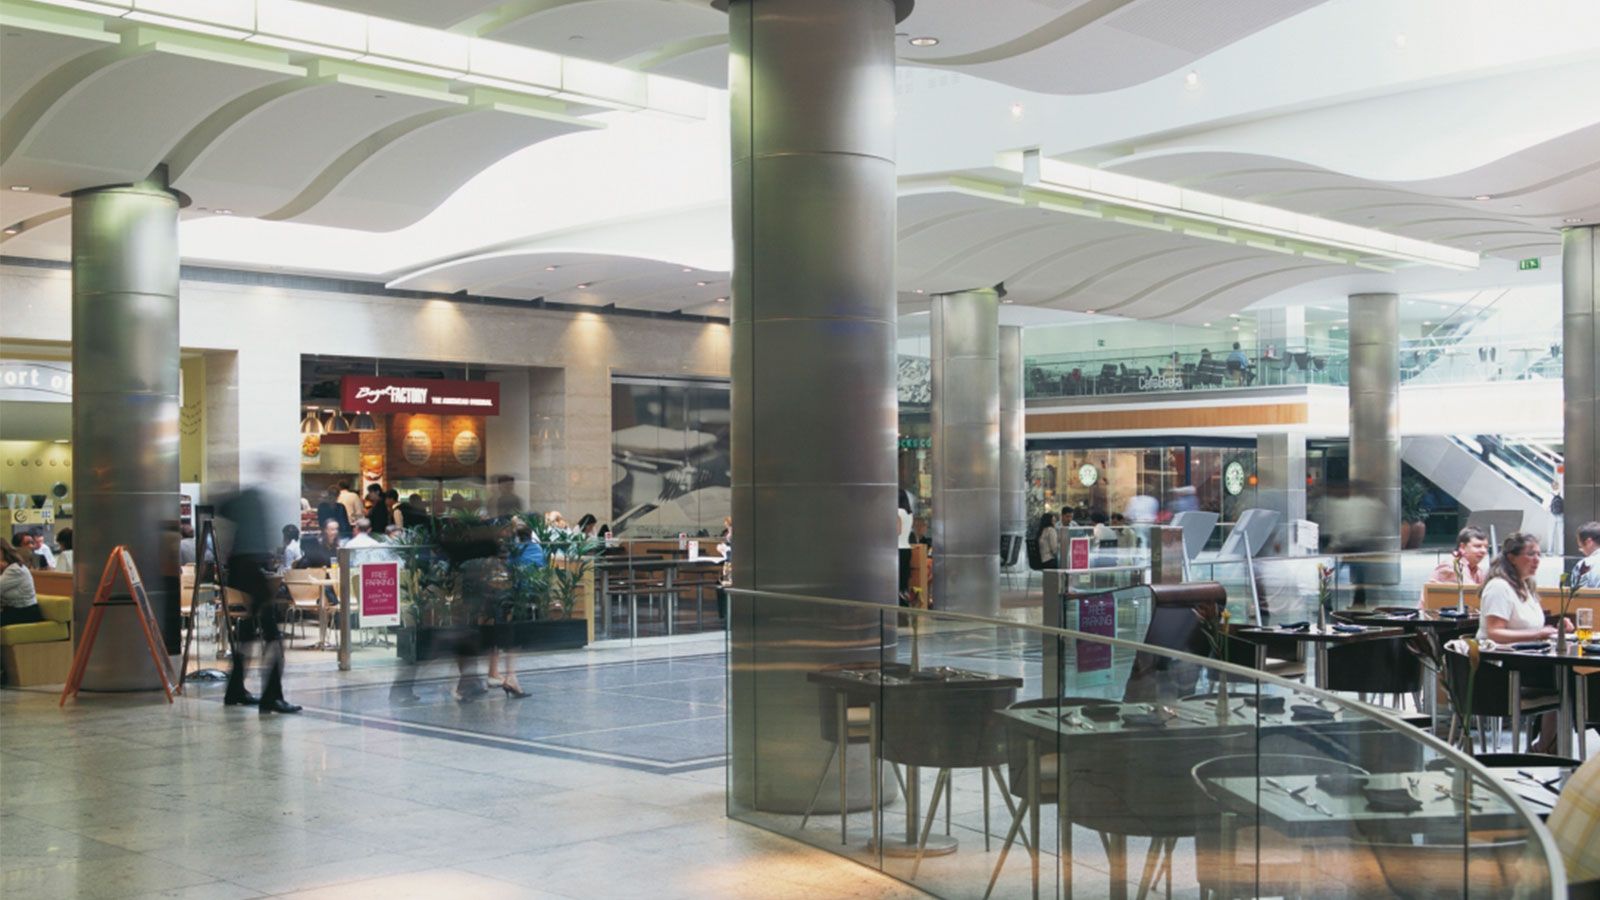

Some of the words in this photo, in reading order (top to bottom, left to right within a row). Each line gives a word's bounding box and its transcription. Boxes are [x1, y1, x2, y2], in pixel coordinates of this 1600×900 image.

[0, 369, 40, 386] ort
[355, 385, 392, 403] Bagel
[390, 386, 427, 403] FACTORY
[371, 571, 388, 579] FREE
[365, 578, 395, 587] PARKING
[1088, 604, 1106, 616] FREE
[1081, 614, 1112, 628] PARKING
